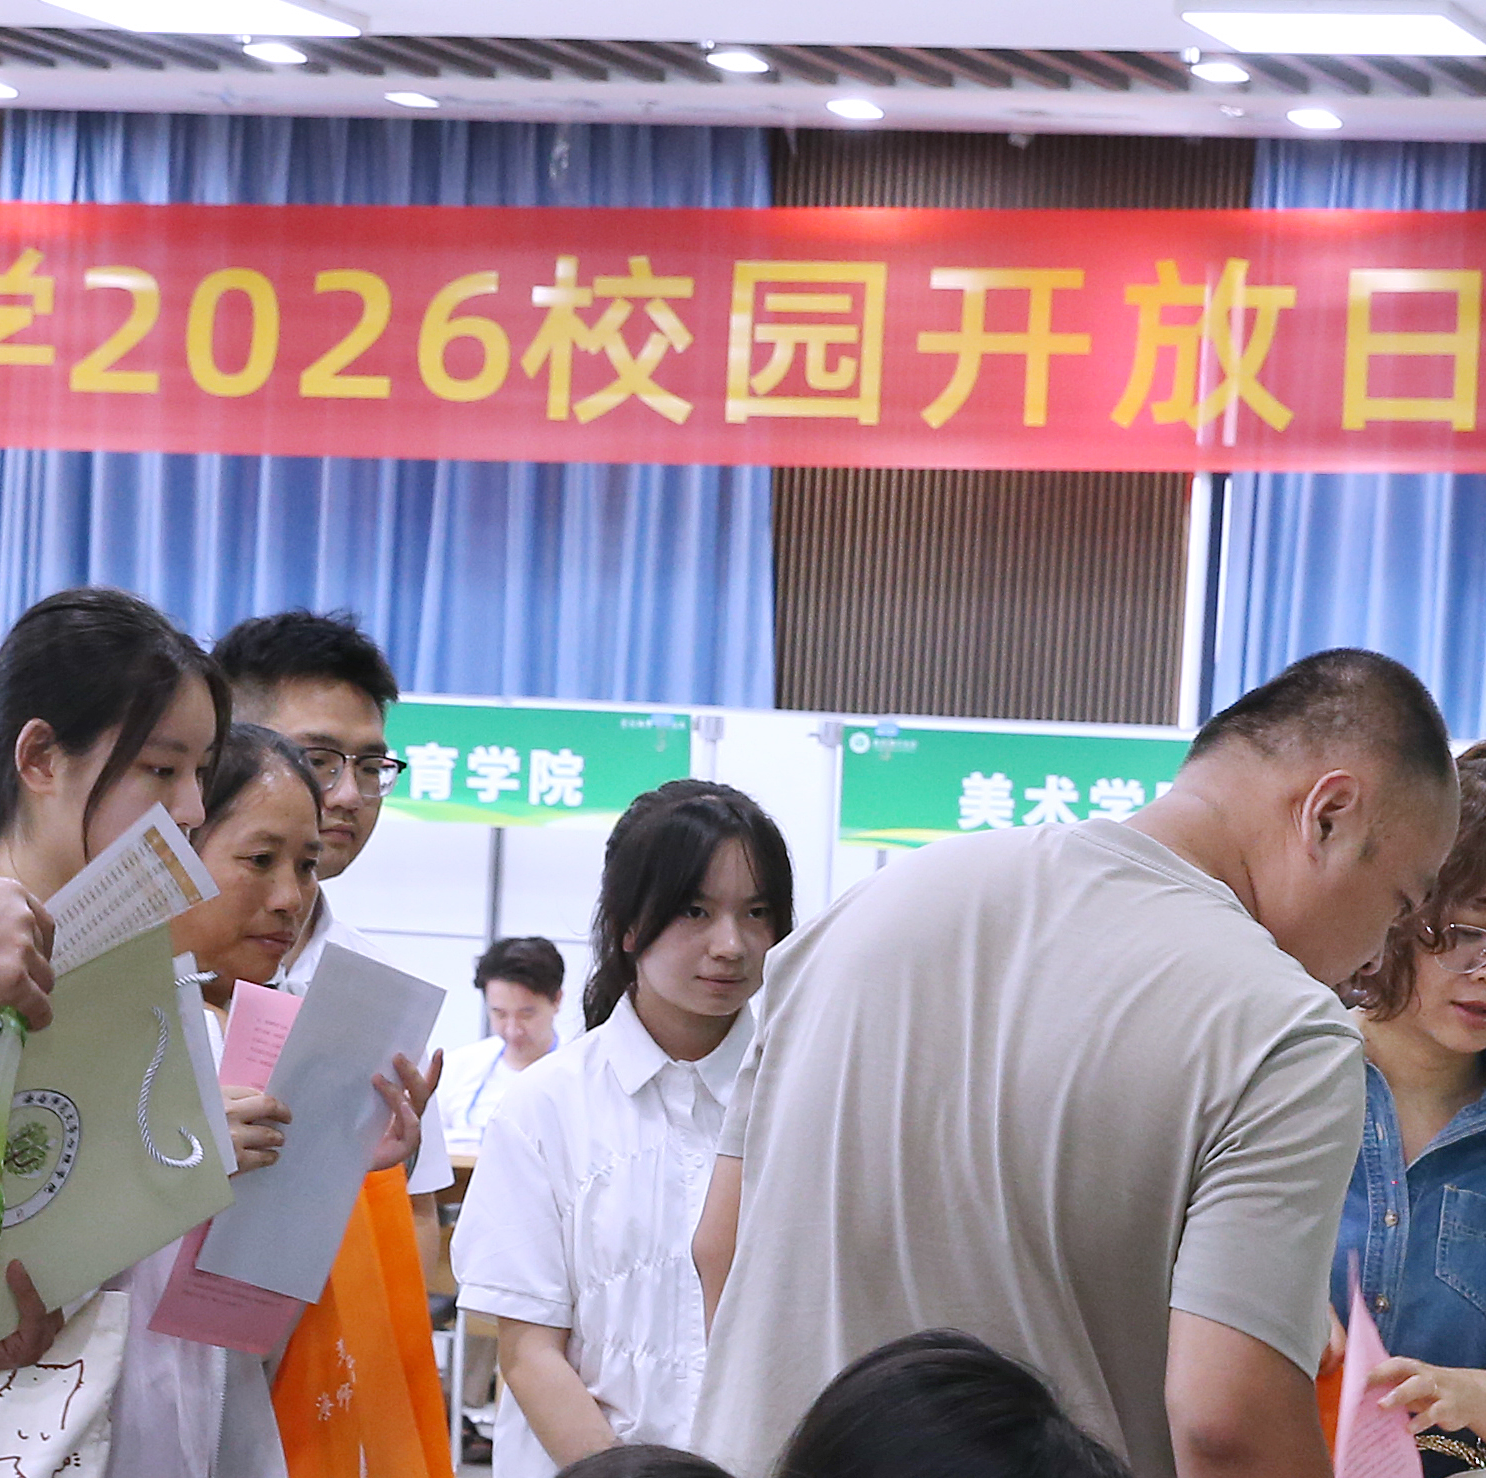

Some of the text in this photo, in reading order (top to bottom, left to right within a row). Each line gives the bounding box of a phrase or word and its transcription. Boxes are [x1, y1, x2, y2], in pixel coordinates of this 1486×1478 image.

[385, 742, 585, 807] 育学院
[957, 770, 1175, 830] 美术学
